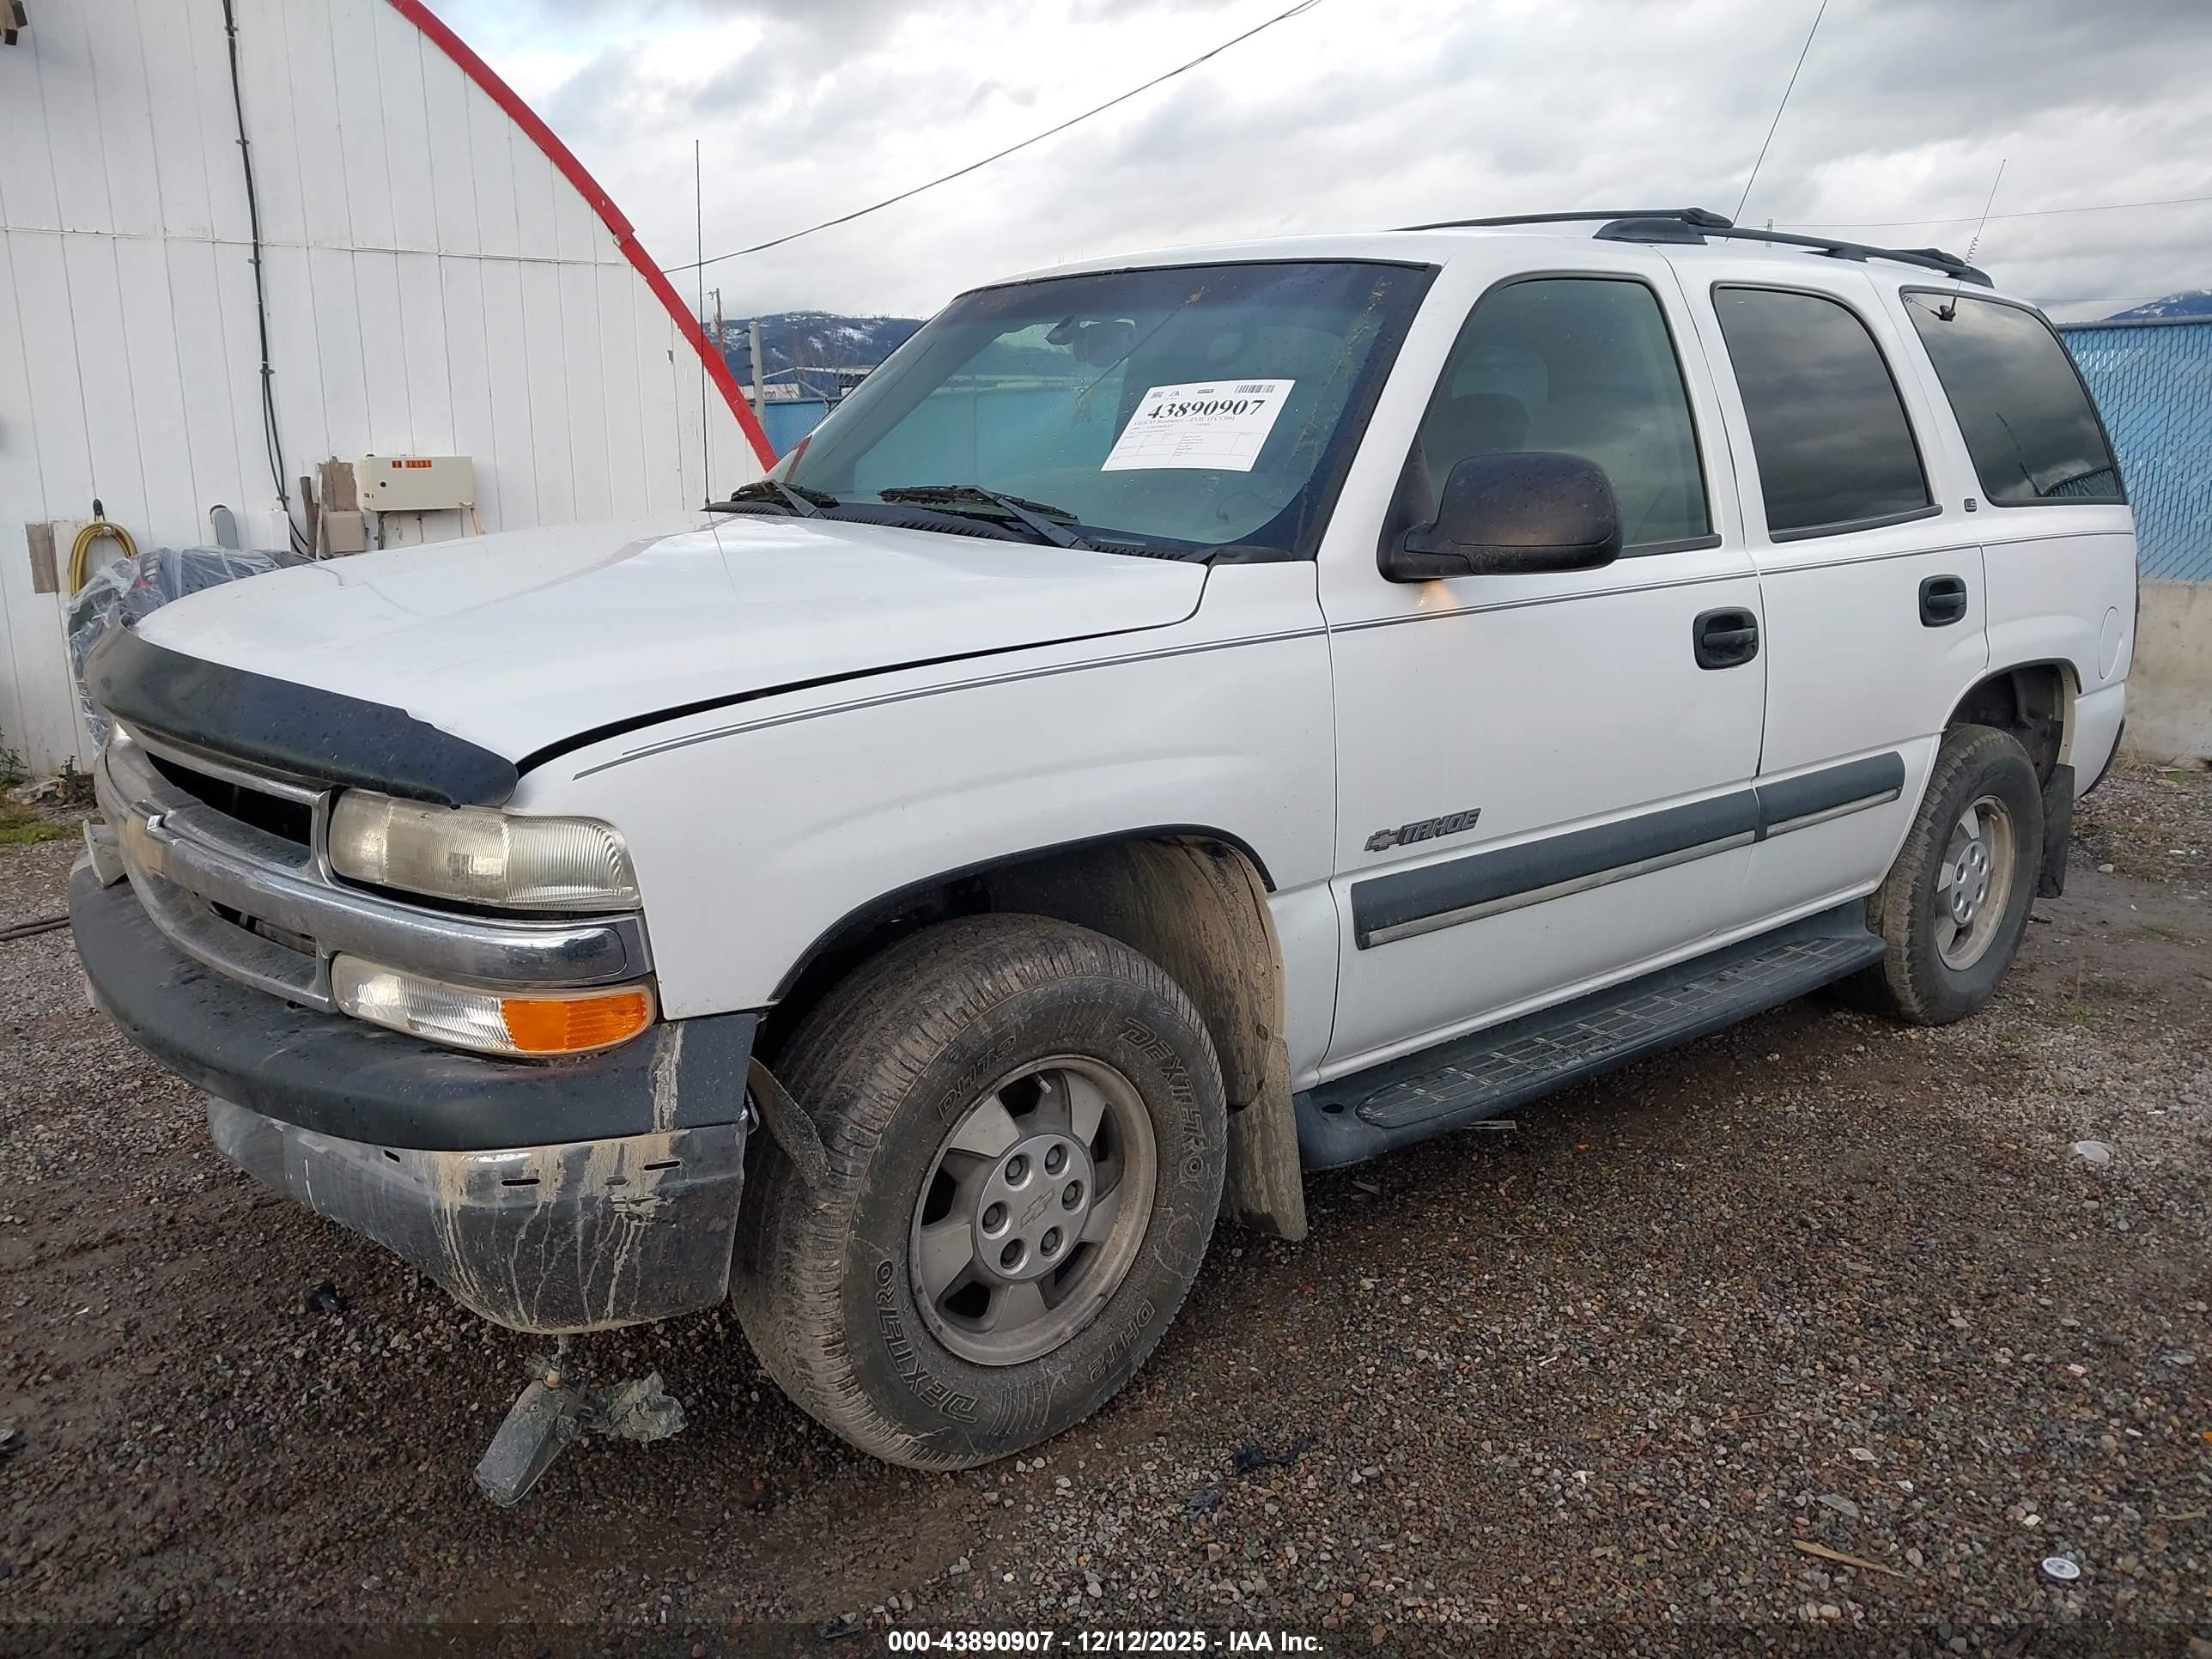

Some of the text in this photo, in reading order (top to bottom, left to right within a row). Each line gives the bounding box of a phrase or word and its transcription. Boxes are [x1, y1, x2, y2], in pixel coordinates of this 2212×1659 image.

[1147, 398, 1267, 420] 43890907
[1399, 807, 1481, 846] TAHOE
[938, 1035, 1017, 1120] DHT2
[1118, 1017, 1210, 1180] DEXTERO
[875, 1258, 979, 1425] DEXTERO
[1087, 1298, 1156, 1382] DHT2
